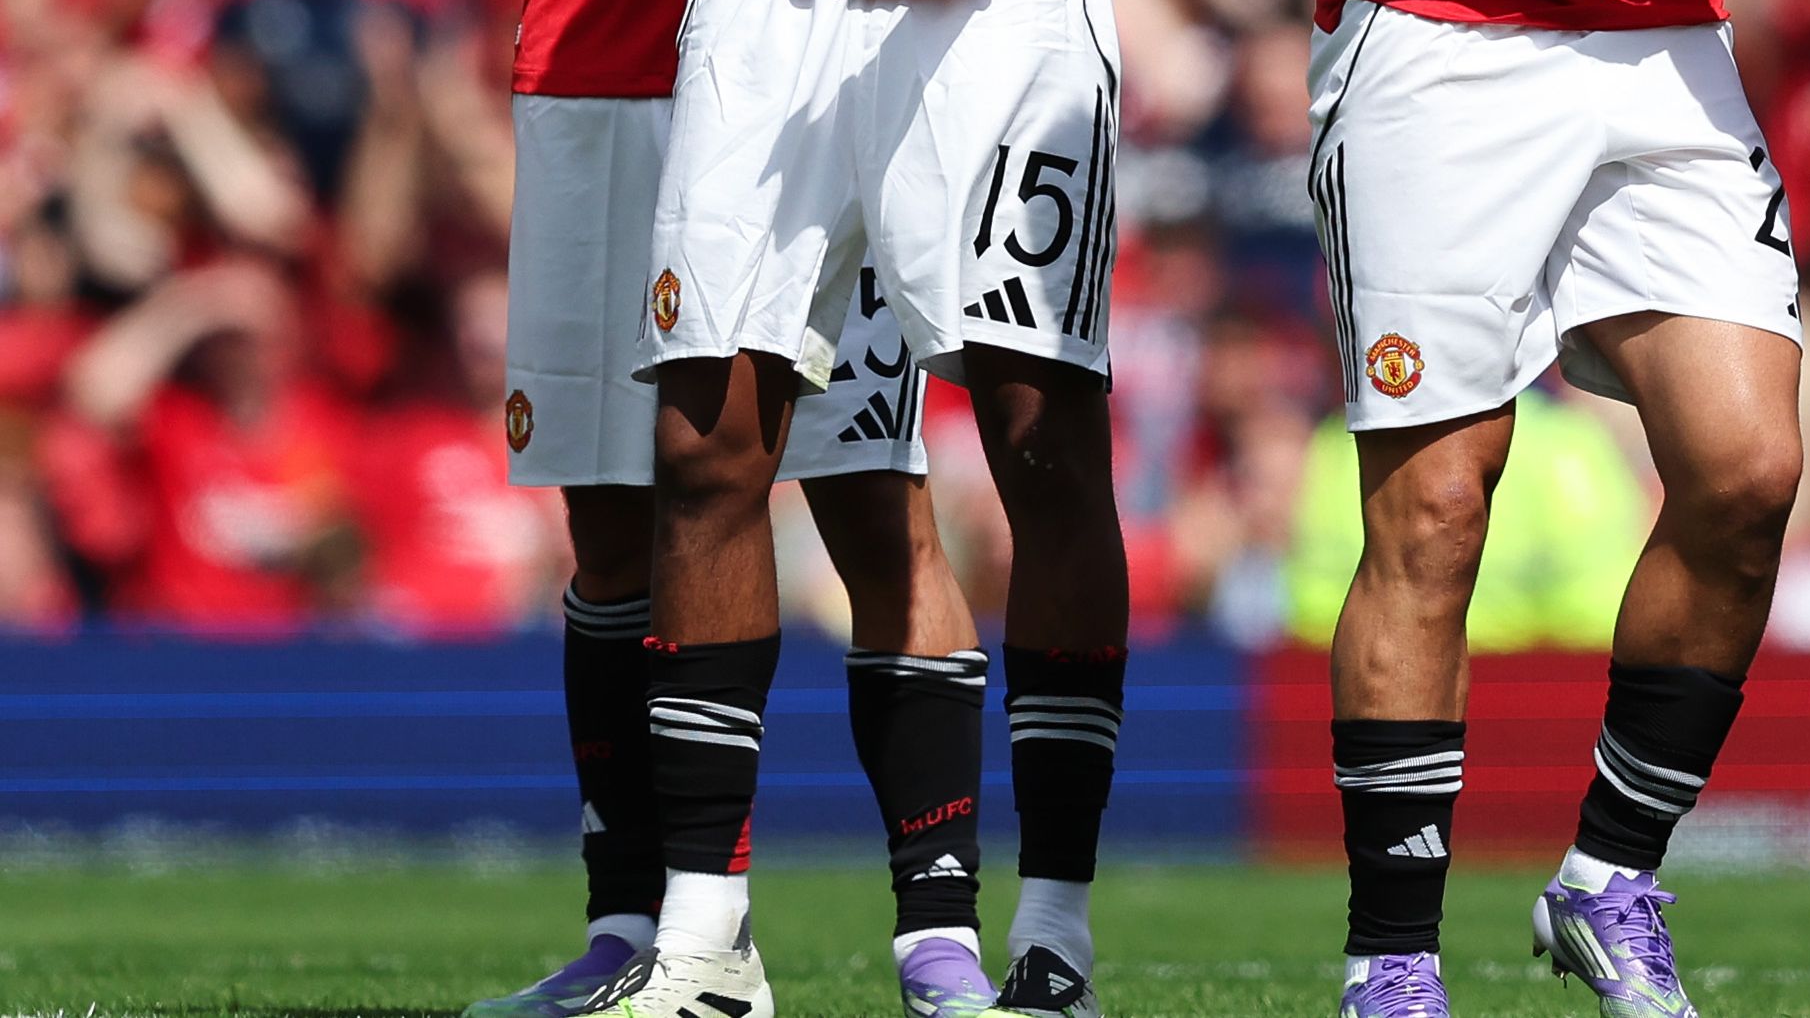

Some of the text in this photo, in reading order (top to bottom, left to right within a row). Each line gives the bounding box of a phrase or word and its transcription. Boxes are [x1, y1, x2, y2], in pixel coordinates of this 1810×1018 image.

[973, 143, 1080, 268] 15
[829, 266, 912, 380] 5
[1369, 338, 1417, 361] MANCHESTER
[1381, 380, 1414, 394] UNITED
[900, 796, 973, 835] MUFC
